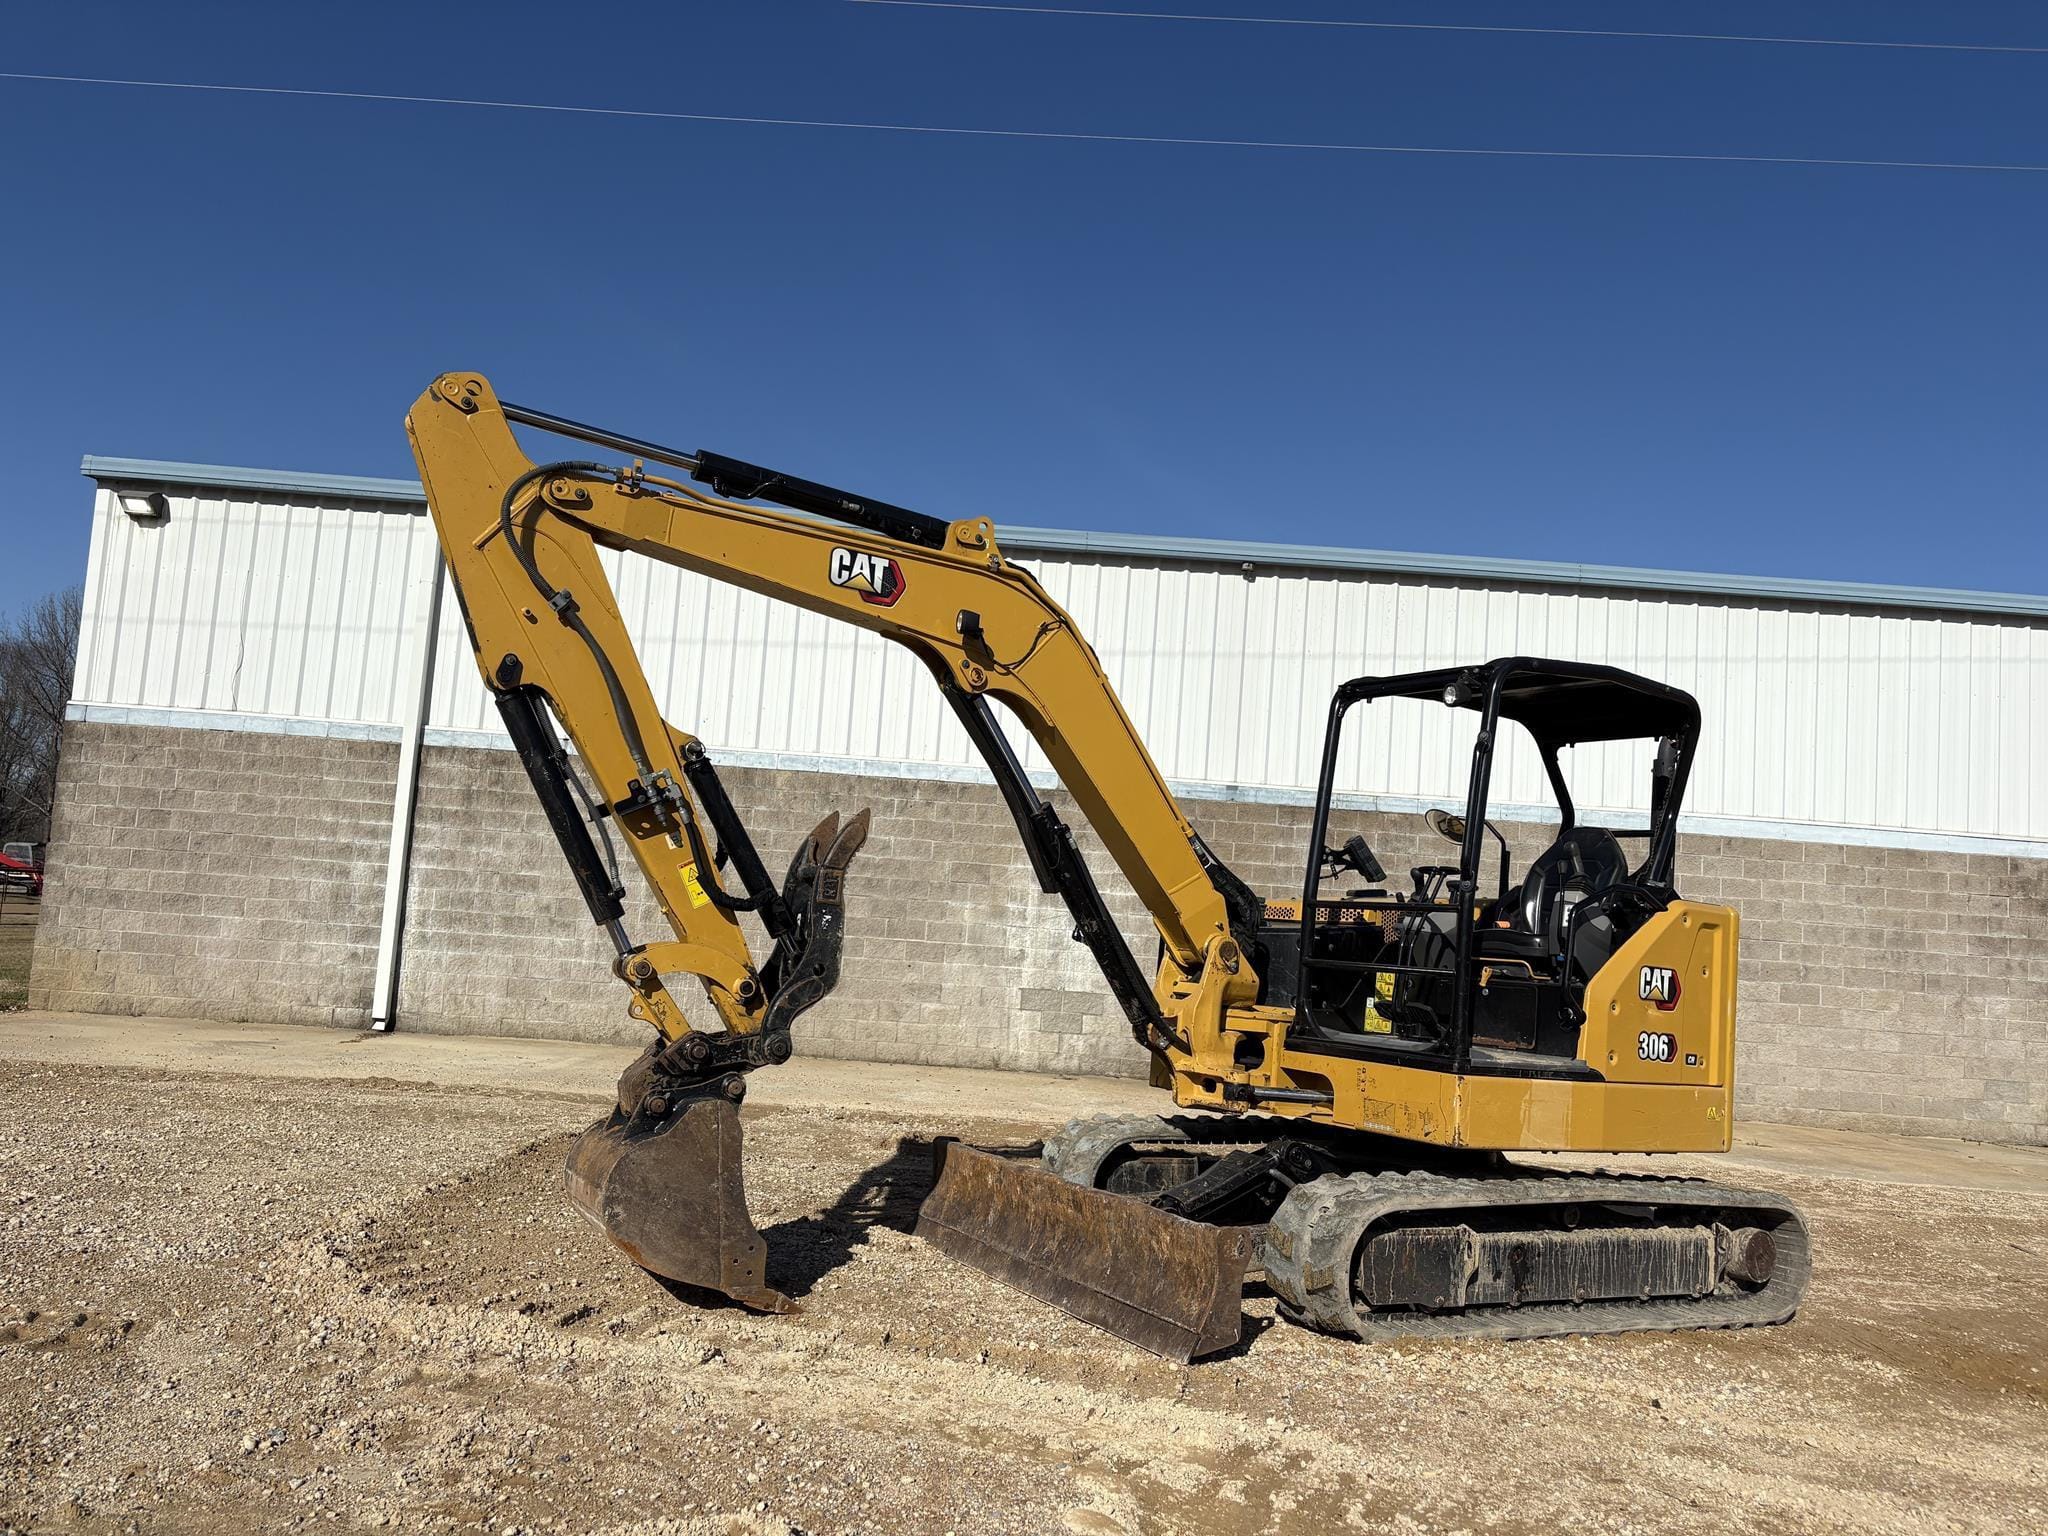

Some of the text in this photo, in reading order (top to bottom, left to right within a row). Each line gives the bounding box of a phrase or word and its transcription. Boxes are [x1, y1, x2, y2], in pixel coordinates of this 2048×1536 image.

[831, 548, 889, 594] CAT
[1640, 967, 1672, 1001] CAT
[1639, 1033, 1669, 1062] 306
